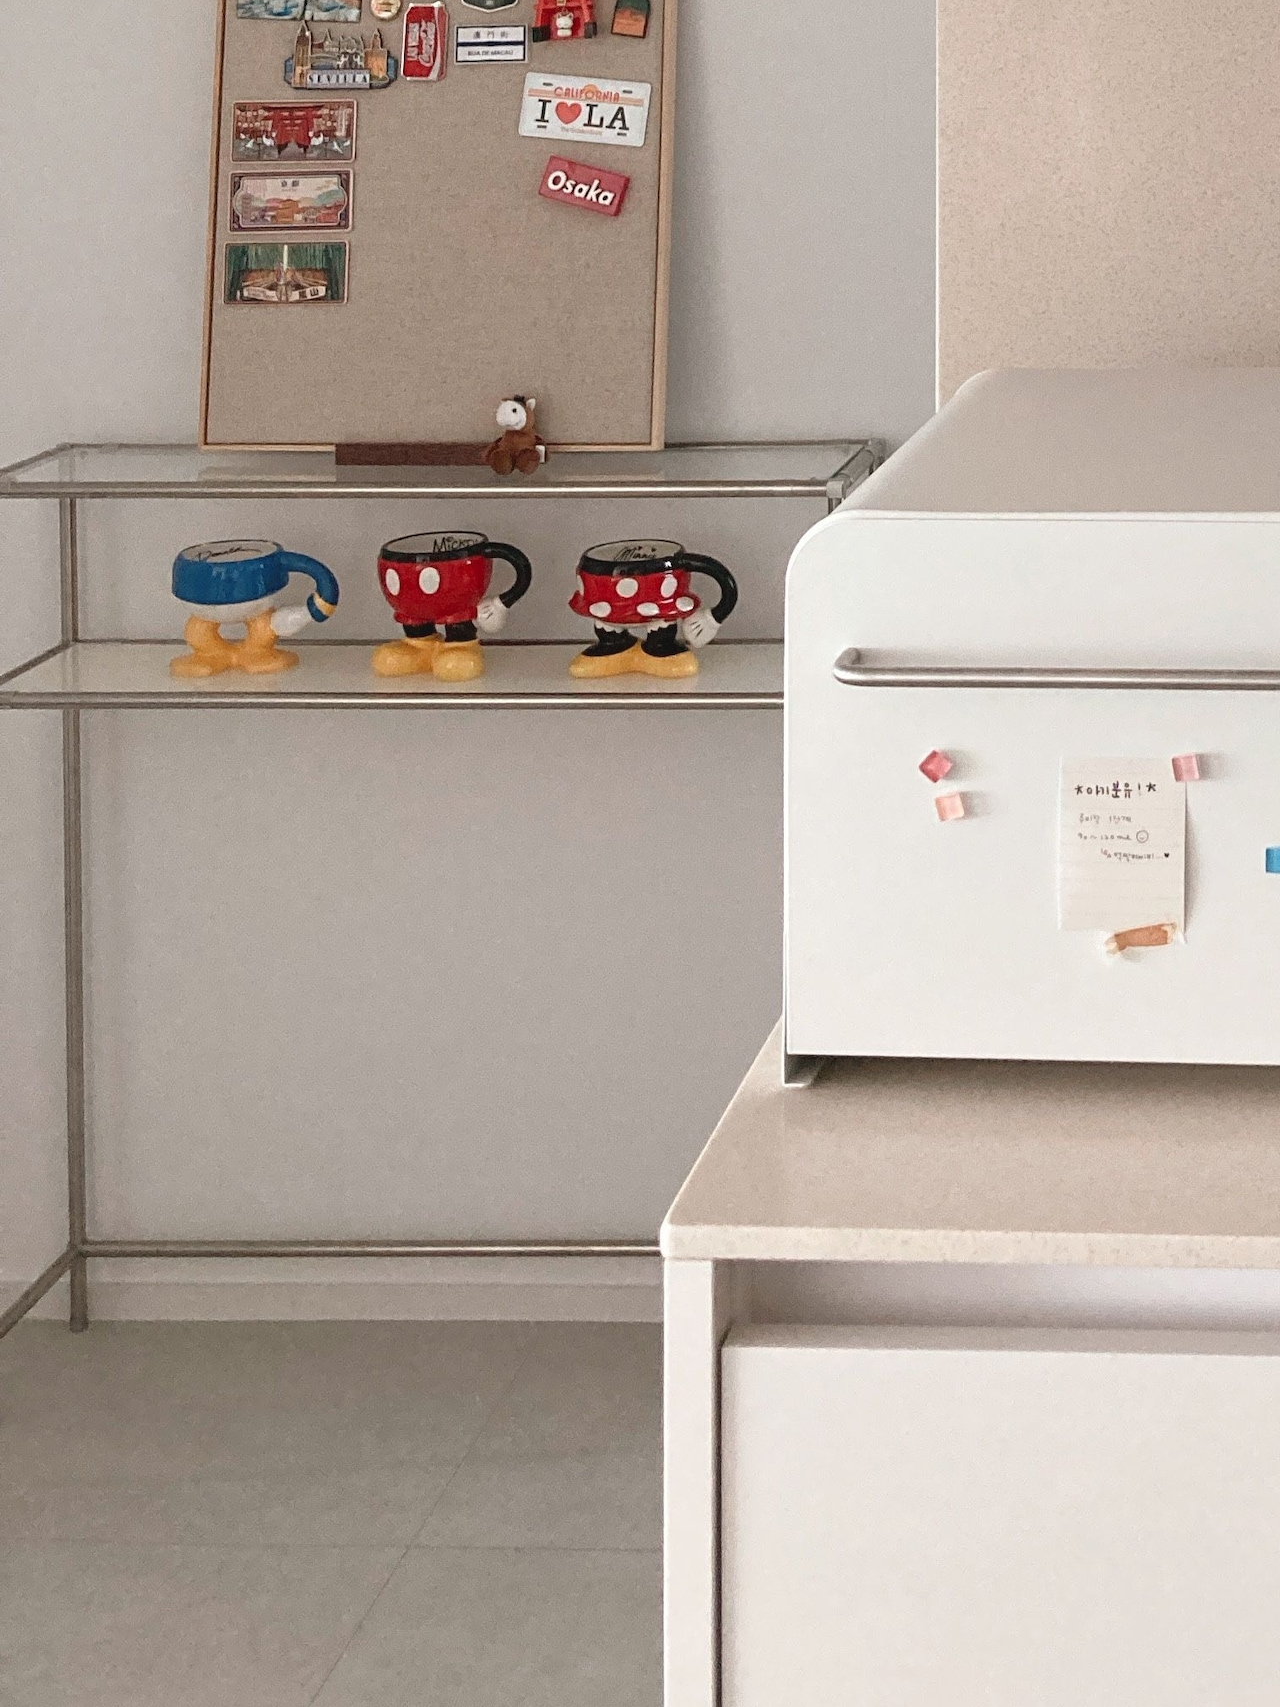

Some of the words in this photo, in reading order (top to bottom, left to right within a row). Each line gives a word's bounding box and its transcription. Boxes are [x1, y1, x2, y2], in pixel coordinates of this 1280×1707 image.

[554, 87, 620, 102] CALIFORNIA
[583, 103, 630, 131] LA
[547, 171, 615, 205] Osaka
